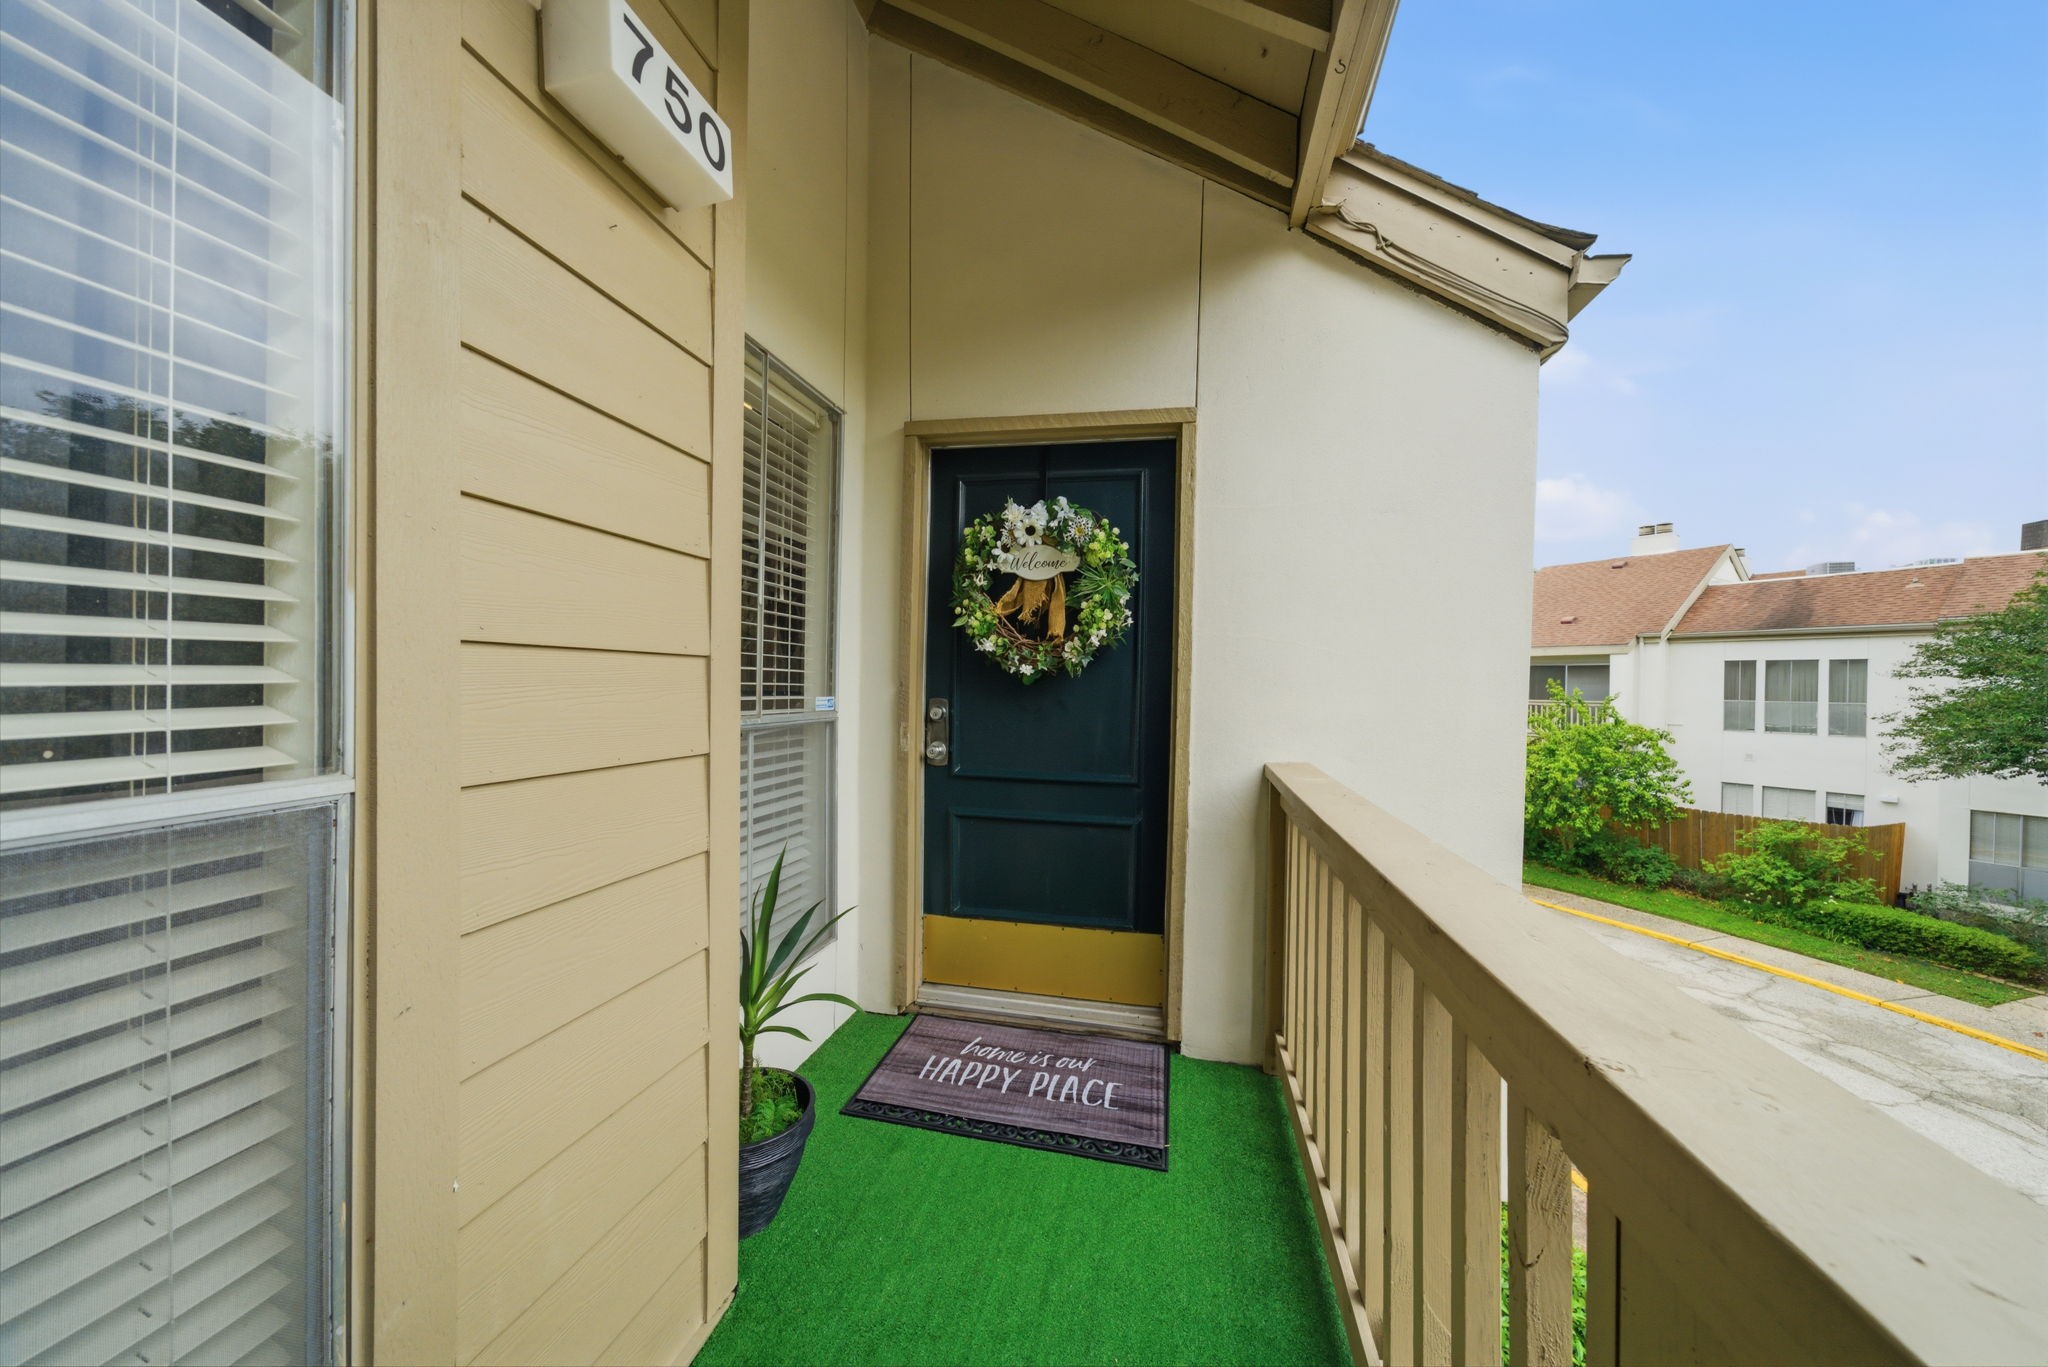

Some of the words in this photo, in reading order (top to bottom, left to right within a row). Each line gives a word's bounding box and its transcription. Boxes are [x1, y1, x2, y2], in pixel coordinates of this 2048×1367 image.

[623, 13, 726, 172] 750
[1009, 551, 1067, 571] Welcome
[960, 1036, 1026, 1063] home
[1027, 1050, 1054, 1068] is
[1056, 1057, 1098, 1072] our
[918, 1055, 1023, 1094] HAPPY
[1028, 1071, 1124, 1110] PLACE
